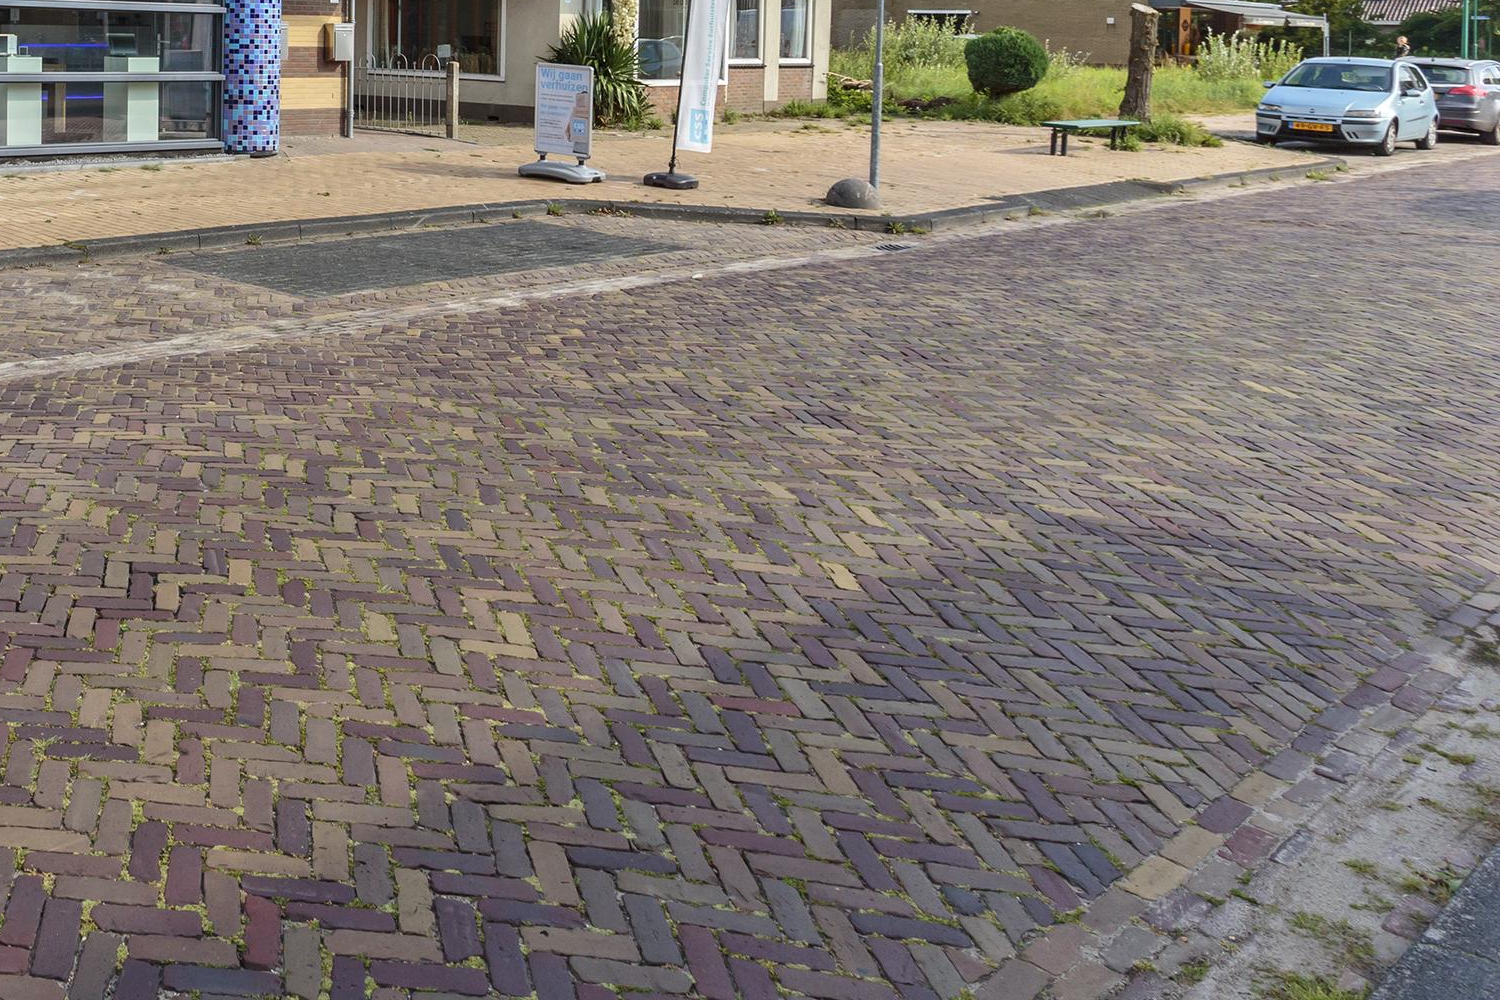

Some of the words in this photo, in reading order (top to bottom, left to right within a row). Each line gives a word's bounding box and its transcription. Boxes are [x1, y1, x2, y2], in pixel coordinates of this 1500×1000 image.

[705, 40, 713, 67] Service
[541, 68, 556, 80] Wij
[559, 71, 583, 81] gaan
[541, 81, 588, 92] verhuizen
[700, 68, 711, 106] Computer
[695, 113, 704, 140] CSS
